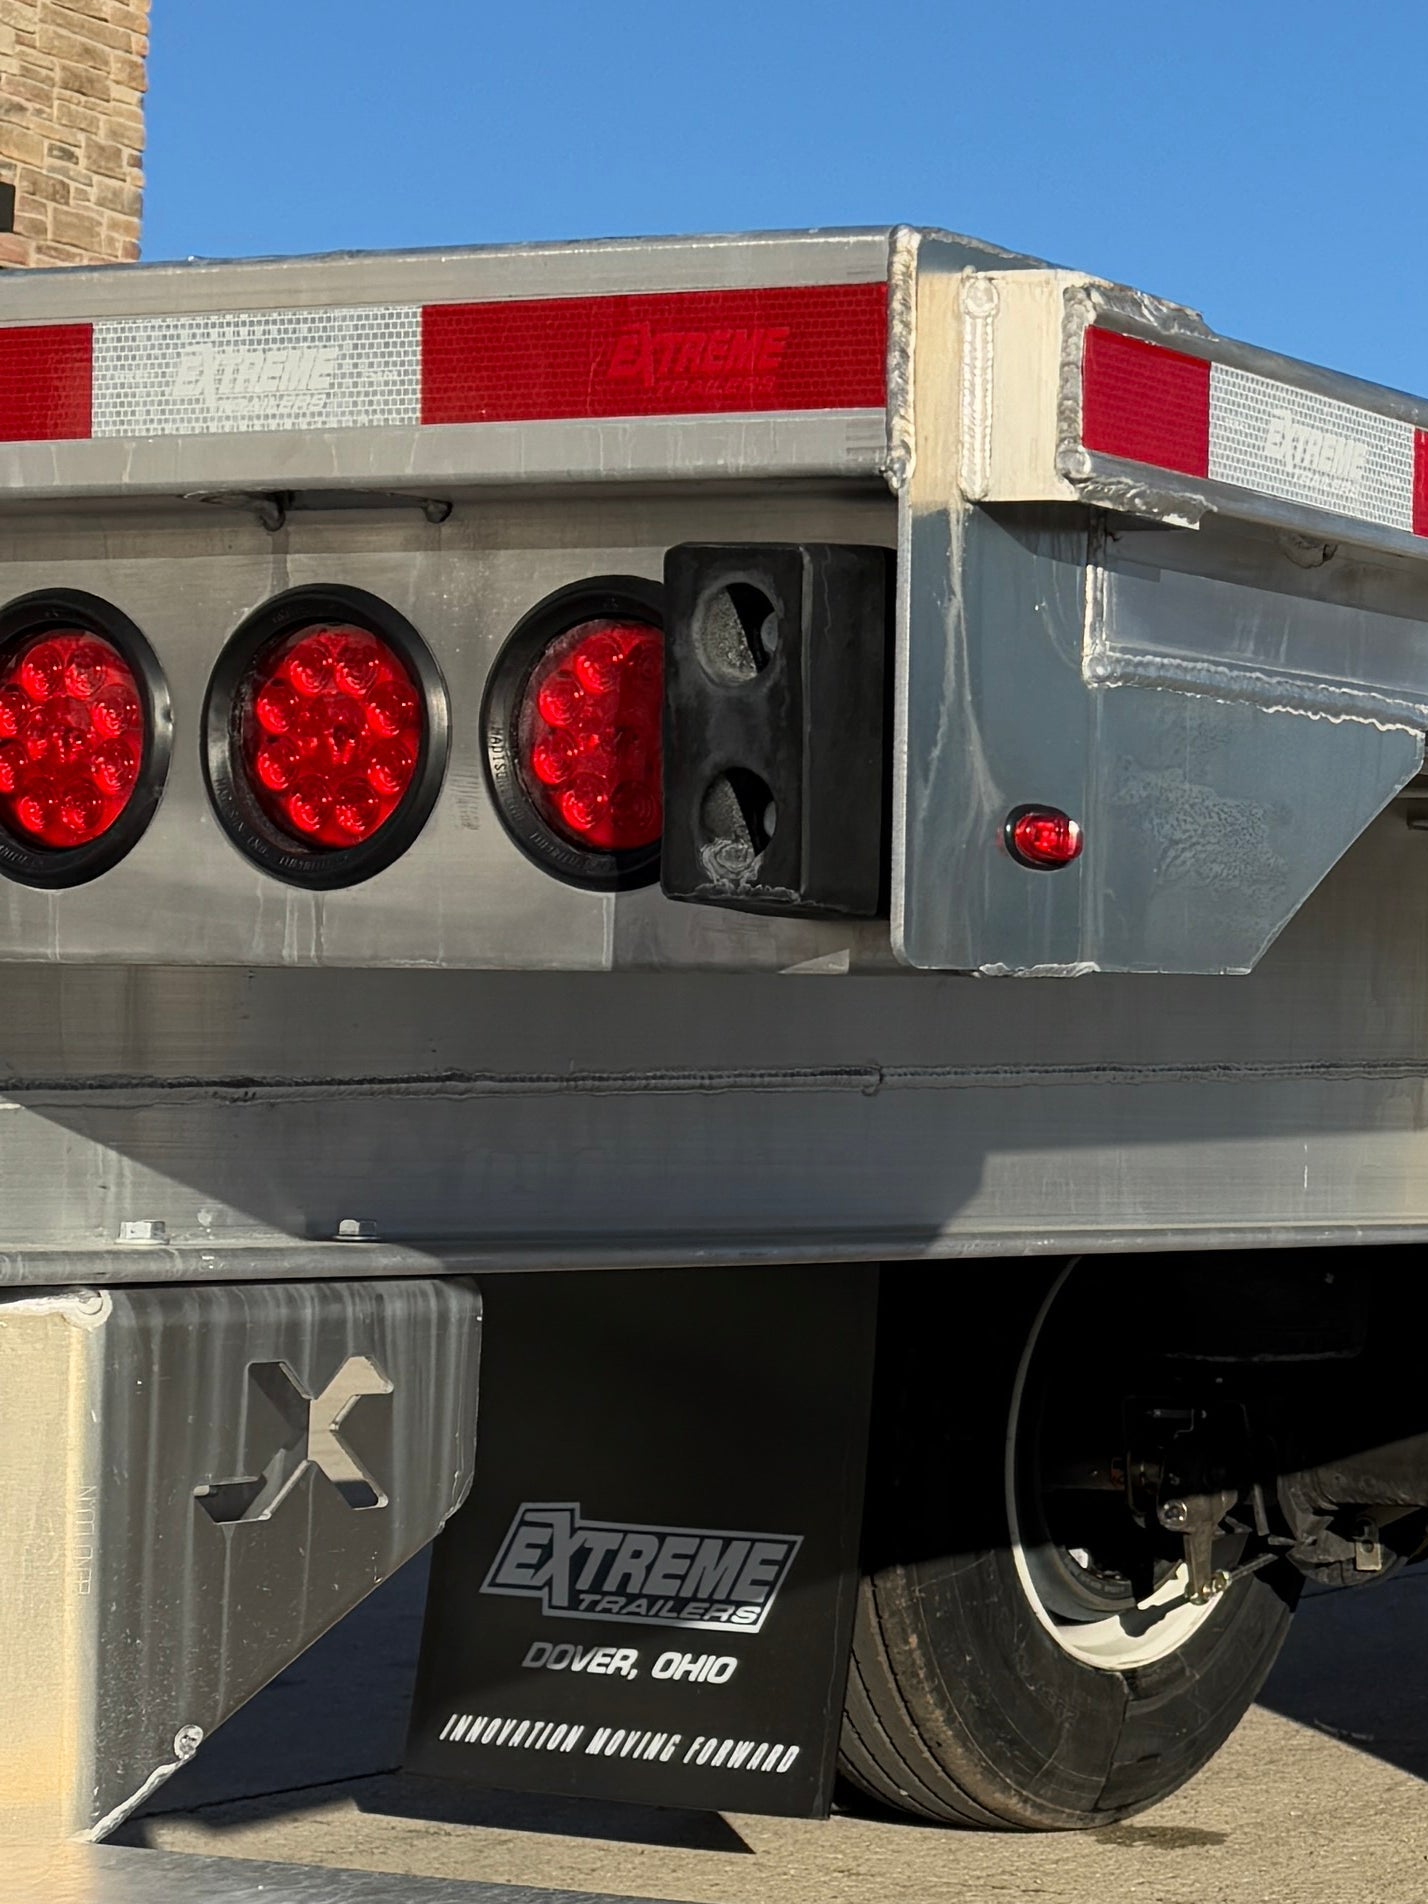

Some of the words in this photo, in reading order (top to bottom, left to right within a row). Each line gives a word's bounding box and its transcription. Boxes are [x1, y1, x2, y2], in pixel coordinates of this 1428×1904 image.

[169, 342, 338, 407] EXTREME
[606, 321, 790, 387] EXTREME
[1264, 408, 1367, 482] EXTREME
[495, 1510, 789, 1607] EXTREME
[576, 1593, 762, 1624] TRAILERS
[521, 1641, 639, 1681] DOVER,
[650, 1651, 738, 1684] OHIO
[439, 1713, 585, 1753] INNOVATION
[585, 1727, 682, 1762] MOVING
[682, 1736, 801, 1773] FORWARD
